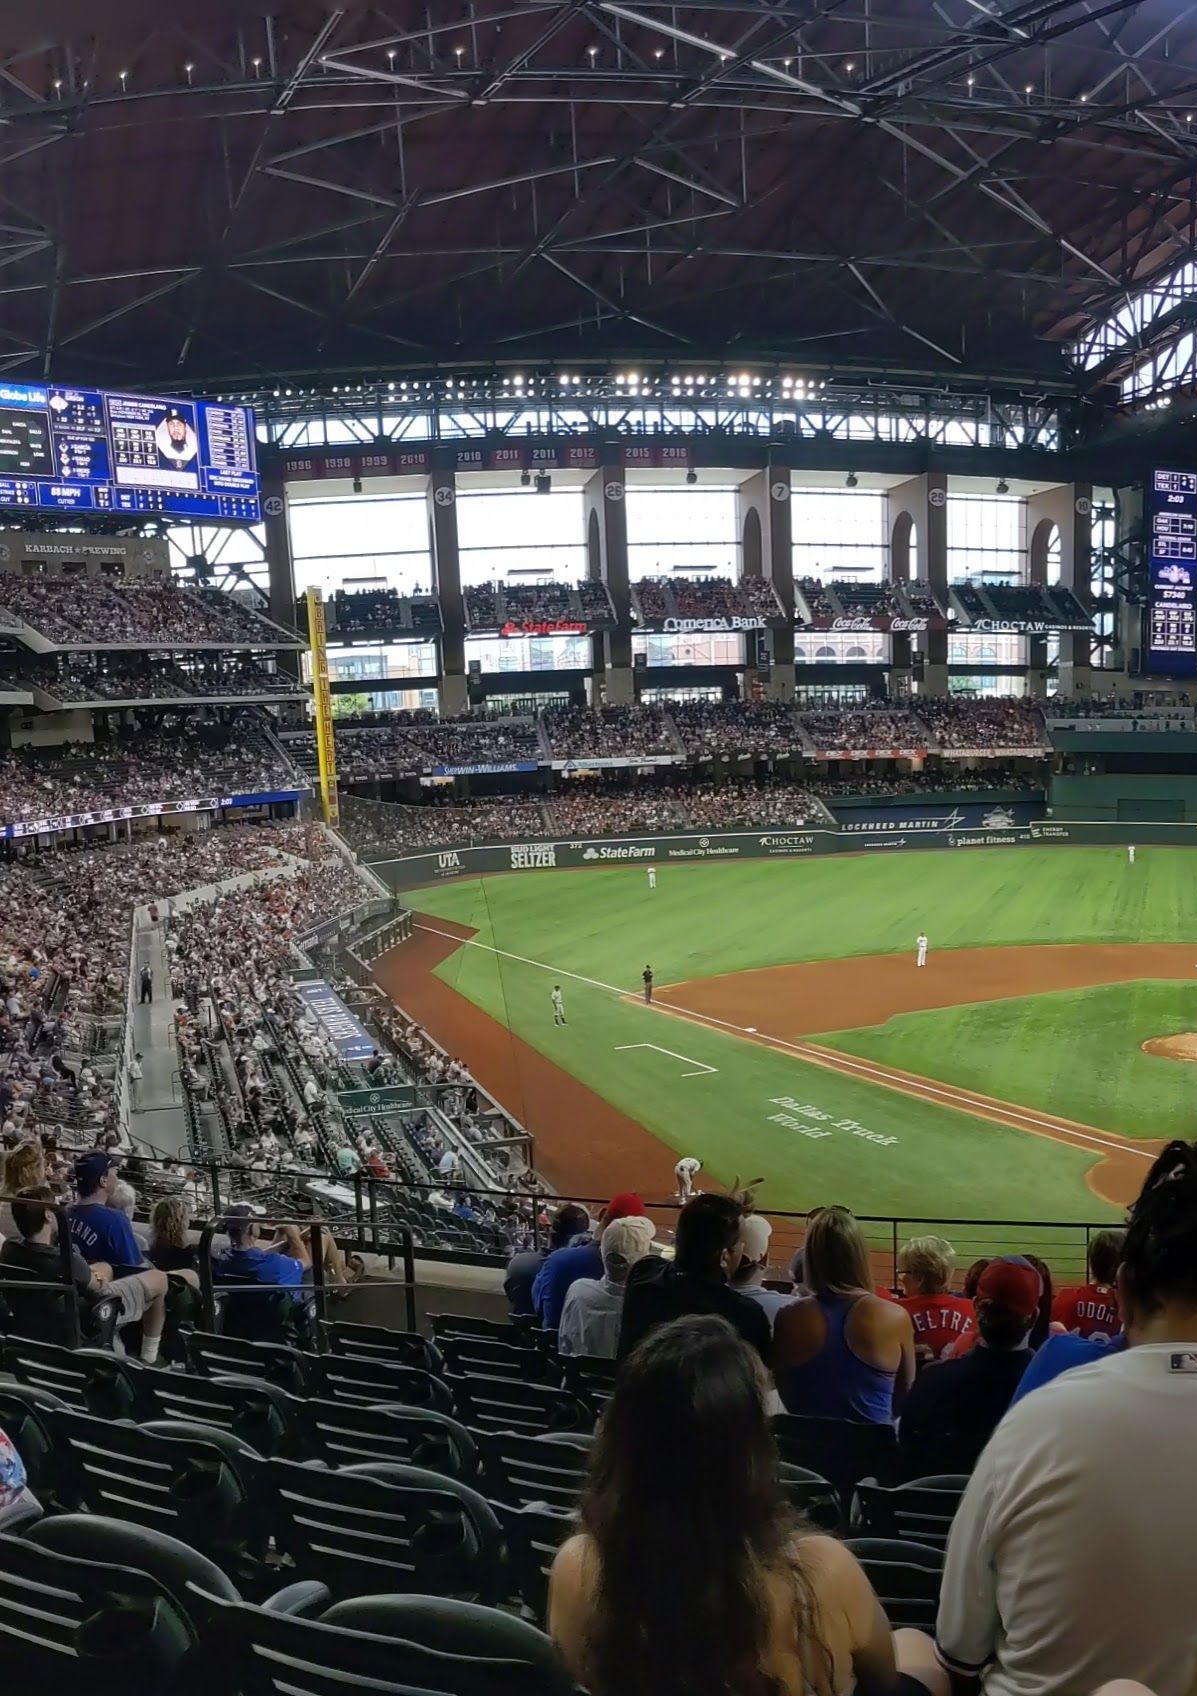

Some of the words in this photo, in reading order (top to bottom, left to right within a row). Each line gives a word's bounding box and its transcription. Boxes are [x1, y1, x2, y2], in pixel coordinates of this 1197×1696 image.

[1, 389, 28, 402] Globe
[28, 391, 46, 403] Life
[457, 451, 481, 461] 2010
[497, 448, 520, 460] 2011
[532, 448, 556, 459] 2011
[569, 447, 595, 458] 2012
[625, 446, 650, 458] 2015
[662, 446, 687, 457] 2016
[325, 457, 351, 469] 1998
[361, 455, 388, 467] 1999
[400, 453, 426, 465] 2010
[66, 487, 81, 498] MPH
[437, 491, 453, 502] 34
[606, 485, 622, 496] 26
[776, 486, 785, 498] 7
[266, 500, 282, 512] 42
[24, 544, 74, 554] KARBACH
[82, 545, 127, 556] BREWING
[731, 614, 768, 629] Bank
[981, 618, 1045, 631] CHOCTAW
[841, 822, 895, 831] LOCKHEED
[898, 820, 939, 829] MARTIN
[765, 836, 814, 846] CHOCTAW
[956, 836, 984, 847] planet
[986, 834, 1016, 845] fitness
[510, 845, 529, 854] BUD
[530, 844, 555, 852] LIGHT
[668, 849, 693, 857] Medical
[692, 848, 706, 857] City
[705, 847, 739, 856] Healthcare
[438, 852, 461, 868] UTA
[510, 851, 557, 869] SELTZER
[765, 1112, 834, 1139] World
[767, 1096, 836, 1121] Dallas
[829, 1118, 901, 1146] Truck
